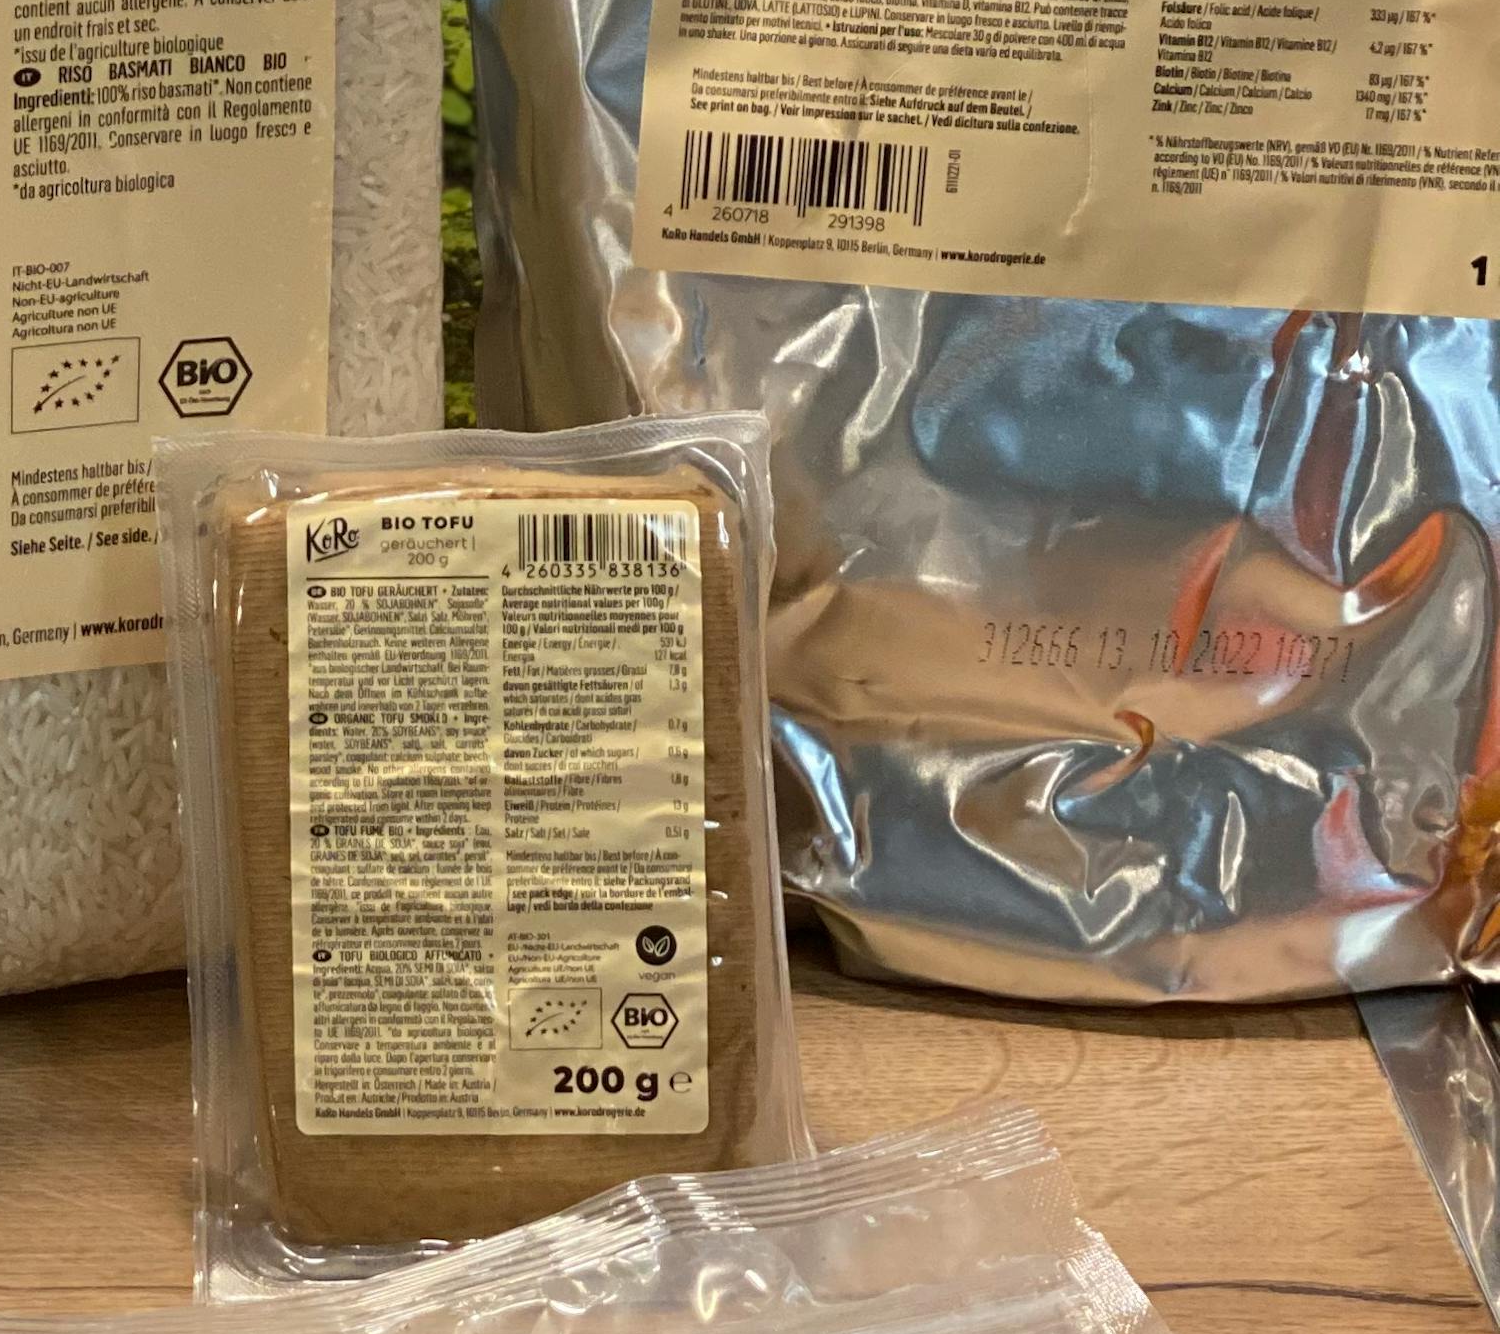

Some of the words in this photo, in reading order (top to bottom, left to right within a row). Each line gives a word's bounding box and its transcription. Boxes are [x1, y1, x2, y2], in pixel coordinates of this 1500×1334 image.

[58, 65, 92, 84] RISO
[108, 58, 172, 81] BASMATI
[189, 54, 245, 75] BIANCO
[263, 51, 287, 71] BIO
[38, 177, 112, 202] agricoltura
[115, 172, 175, 193] biologica
[662, 202, 673, 218] 4
[711, 205, 769, 224] 260718
[827, 213, 885, 232] 291398
[661, 227, 687, 241] KoRo
[688, 228, 729, 243] Handels
[730, 230, 761, 245] GmbH
[767, 234, 825, 251] Koppenplatz
[860, 240, 890, 256] Berlin,
[892, 243, 933, 261] Germany
[940, 249, 1046, 267] www.korodrogerie.de
[12, 270, 150, 293] Nicht-EU-Landwirtschaft
[1471, 255, 1487, 286] 1
[12, 289, 120, 308] Non-EU-agriculture
[11, 467, 79, 490] Mindestens
[81, 462, 124, 479] haltbar
[127, 460, 145, 475] bis
[381, 516, 416, 530] BIO
[421, 515, 474, 530] TOFU
[306, 517, 359, 561] KoRo
[379, 536, 468, 554] geräuchert
[406, 551, 436, 566] 200
[438, 554, 449, 569] g
[501, 564, 511, 579] 4
[527, 564, 597, 579] 260335
[609, 563, 680, 578] 838136
[12, 626, 69, 645] Germany
[639, 971, 676, 983] vegan
[552, 1065, 625, 1094] 200
[634, 1071, 659, 1102] g
[554, 1107, 646, 1119] www.korodrogerie.de
